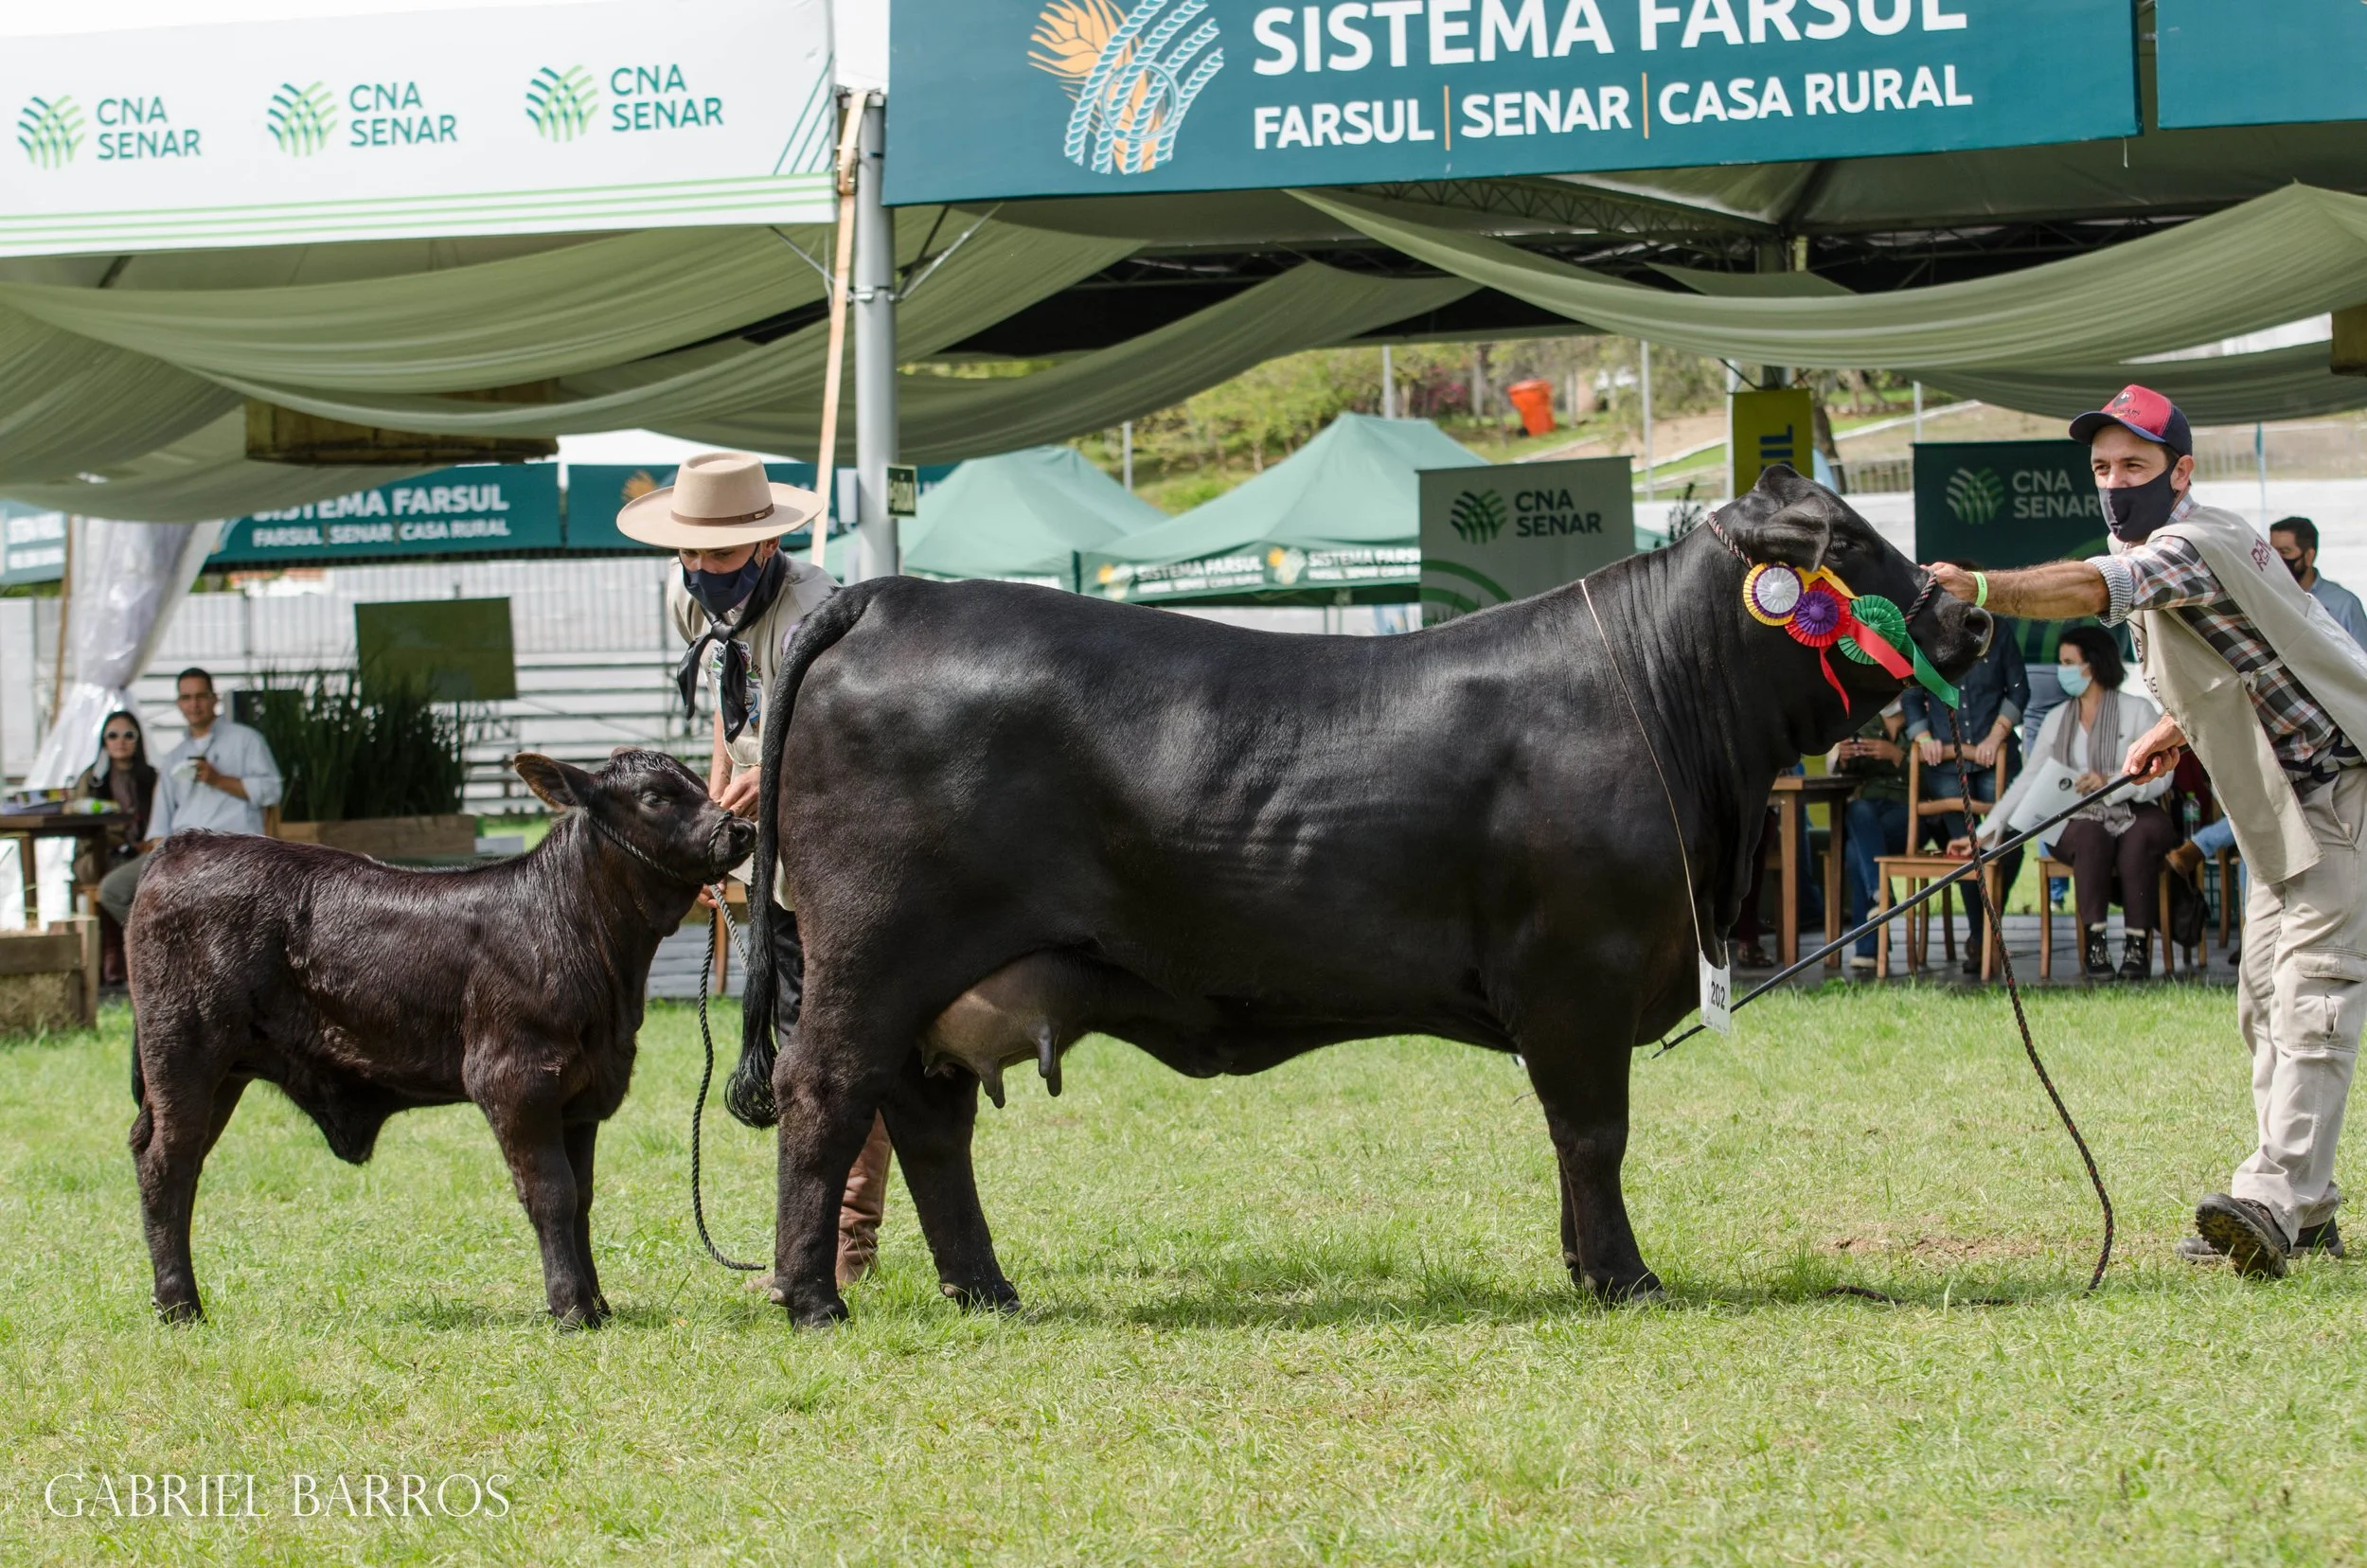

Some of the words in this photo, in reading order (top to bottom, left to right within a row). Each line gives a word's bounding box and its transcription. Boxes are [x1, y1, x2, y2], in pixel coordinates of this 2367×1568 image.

[1253, 0, 1614, 76] SISTEMA
[611, 63, 686, 97] CNA
[97, 96, 168, 126] CNA
[348, 81, 422, 112] CNA
[1255, 98, 1434, 150] FARSUL
[1461, 86, 1632, 138] SENAR
[1658, 77, 1793, 125] CASA
[1805, 64, 1973, 116] RURAL
[612, 98, 723, 132] SENAR
[97, 129, 202, 160] SENAR
[349, 115, 457, 147] SENAR
[2012, 469, 2072, 493] CNA
[392, 483, 510, 515] FARSUL
[1515, 489, 1574, 512] CNA
[2013, 494, 2101, 519] SENAR
[329, 522, 393, 544] SENAR
[1516, 512, 1603, 538] SENAR
[1710, 979, 1726, 1011] 202
